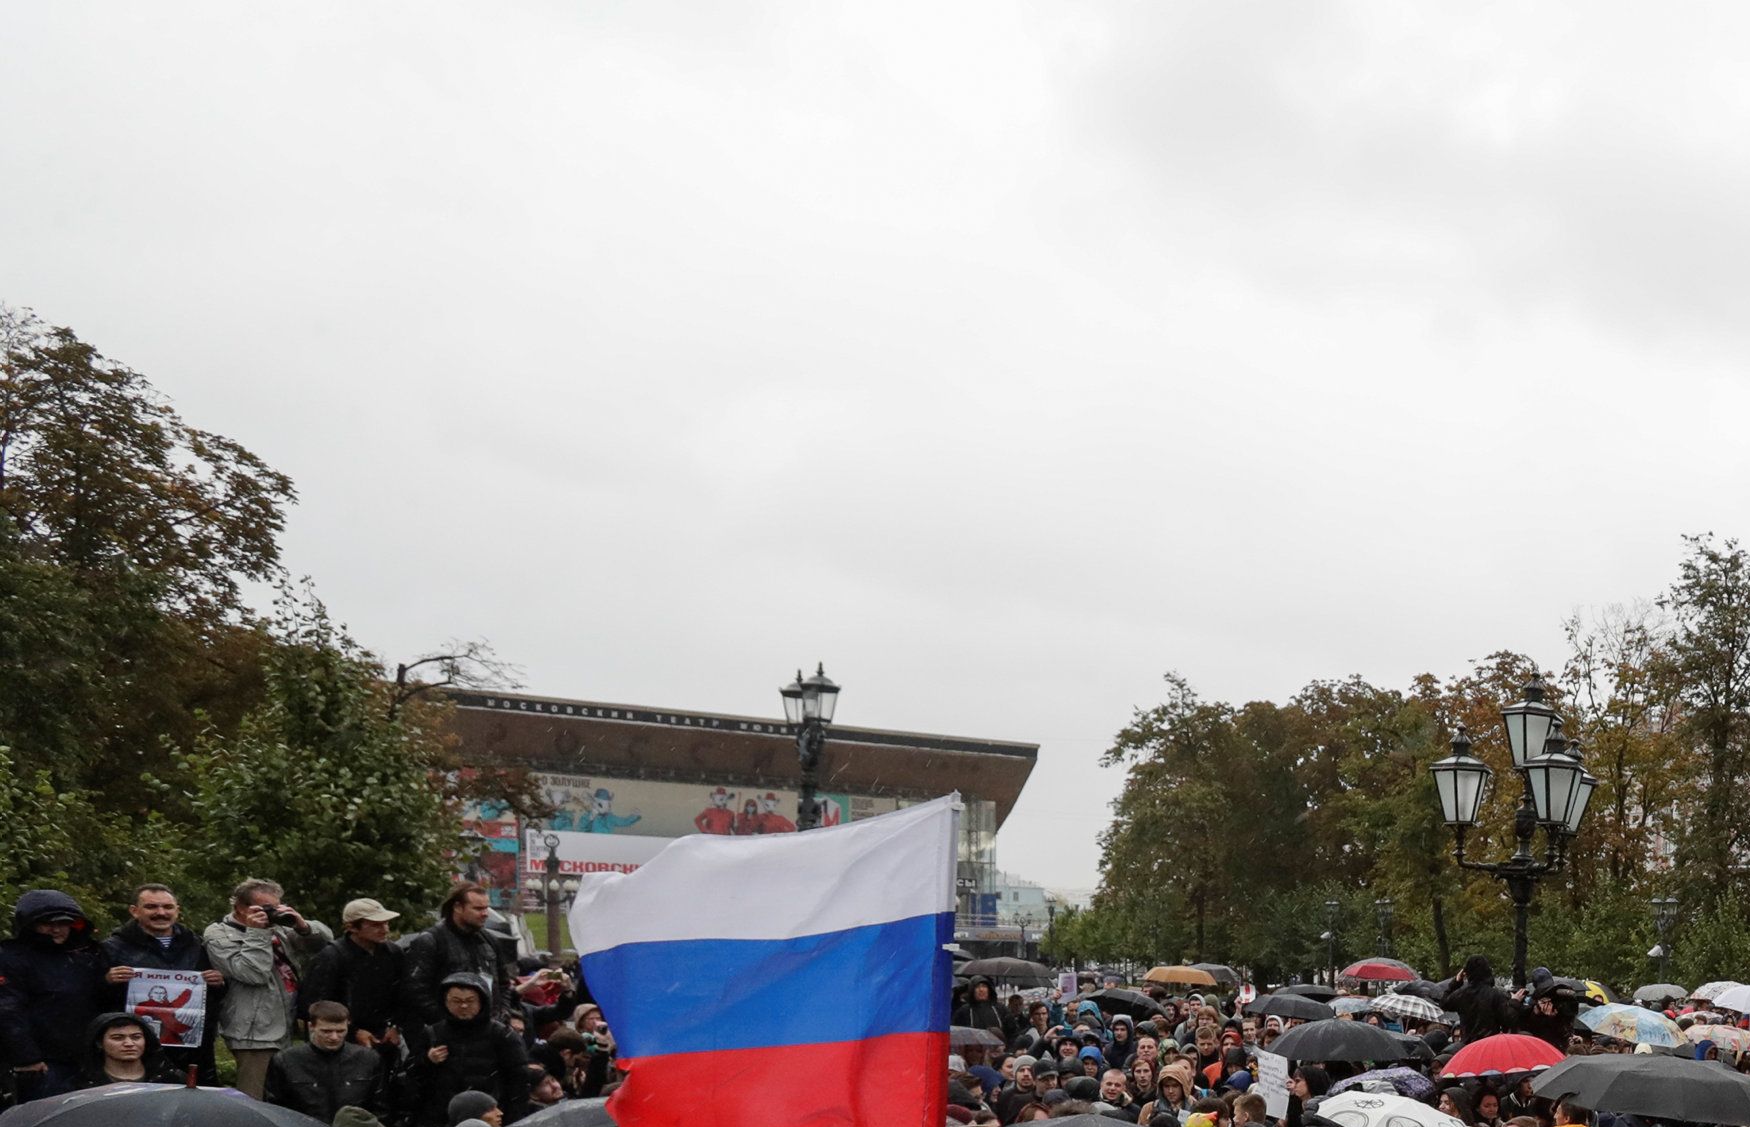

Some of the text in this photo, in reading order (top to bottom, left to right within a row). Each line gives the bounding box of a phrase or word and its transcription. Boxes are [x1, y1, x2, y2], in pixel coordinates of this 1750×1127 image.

[655, 714, 720, 729] ТЕАТР
[739, 722, 799, 735] МЮЗИ
[530, 859, 641, 874] МСКОВСК
